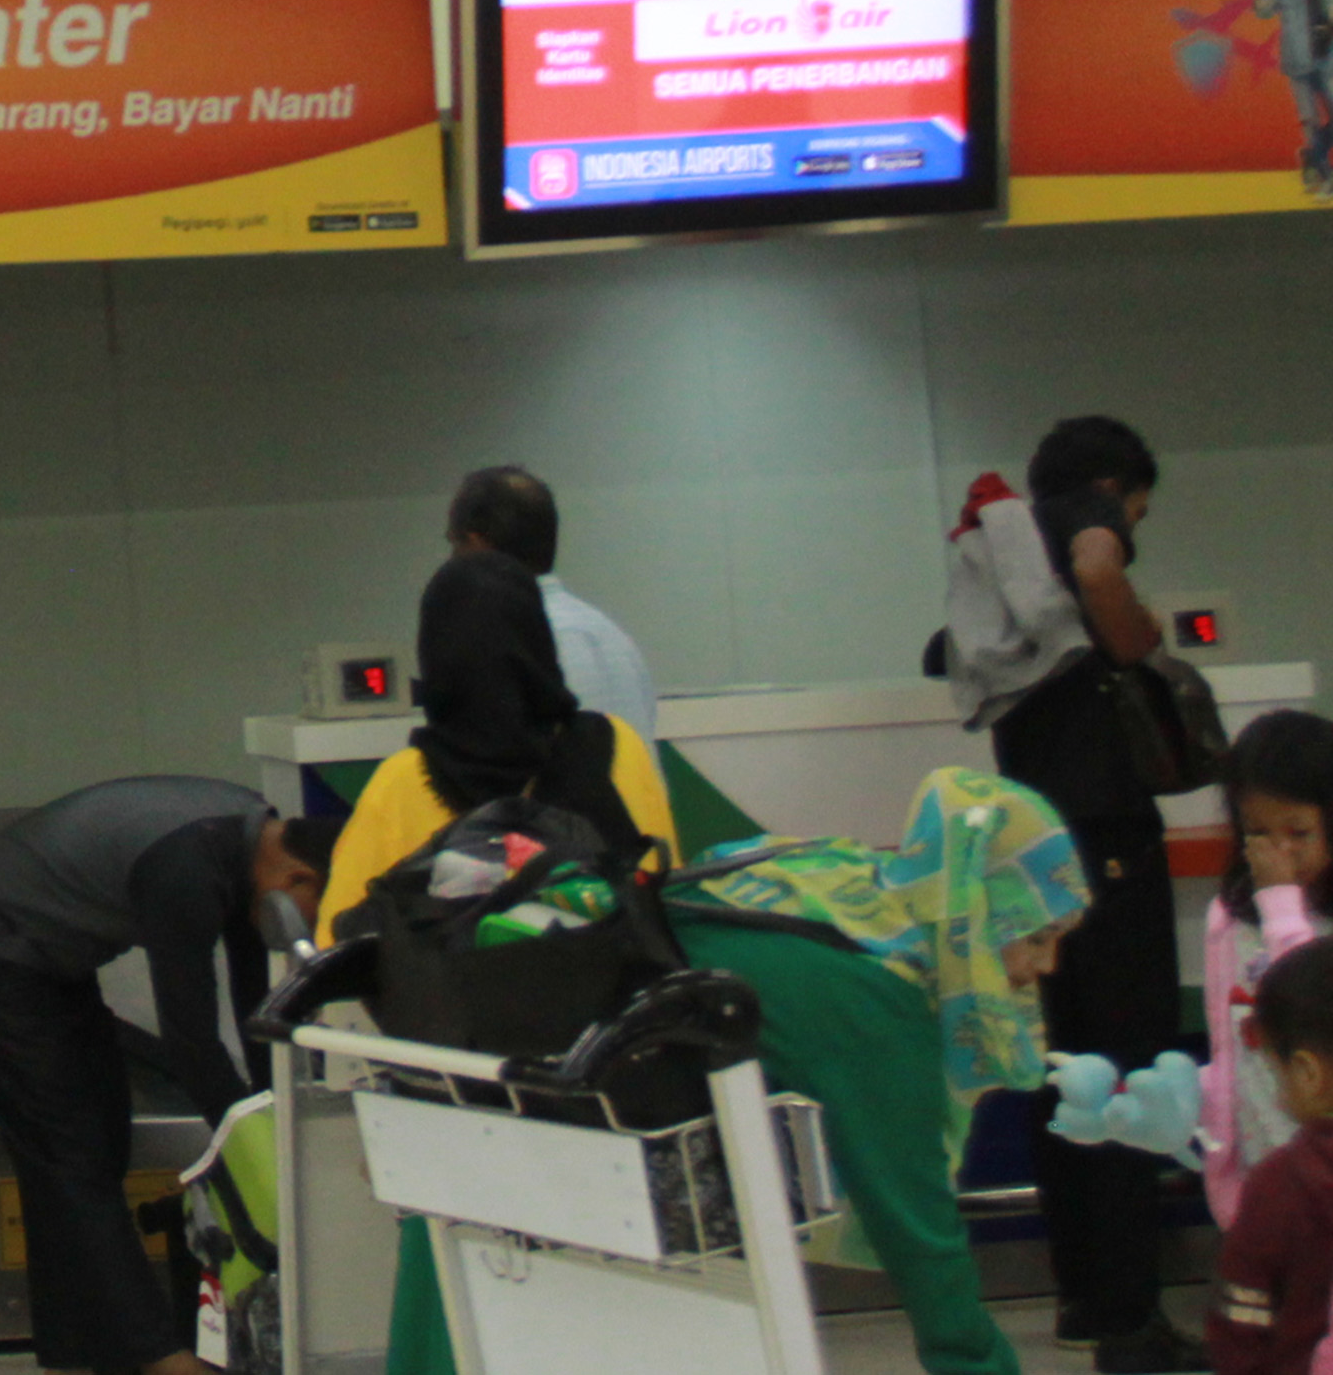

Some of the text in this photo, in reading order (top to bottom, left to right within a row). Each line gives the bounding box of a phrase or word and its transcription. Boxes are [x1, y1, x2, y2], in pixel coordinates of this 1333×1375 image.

[704, 2, 891, 39] Lion air
[654, 57, 947, 100] SEMUA PENERBANGAN
[123, 89, 239, 132] Bayar
[248, 84, 355, 124] Nanti
[583, 150, 680, 182] INDONESIA
[684, 143, 774, 176] AIRPORTS
